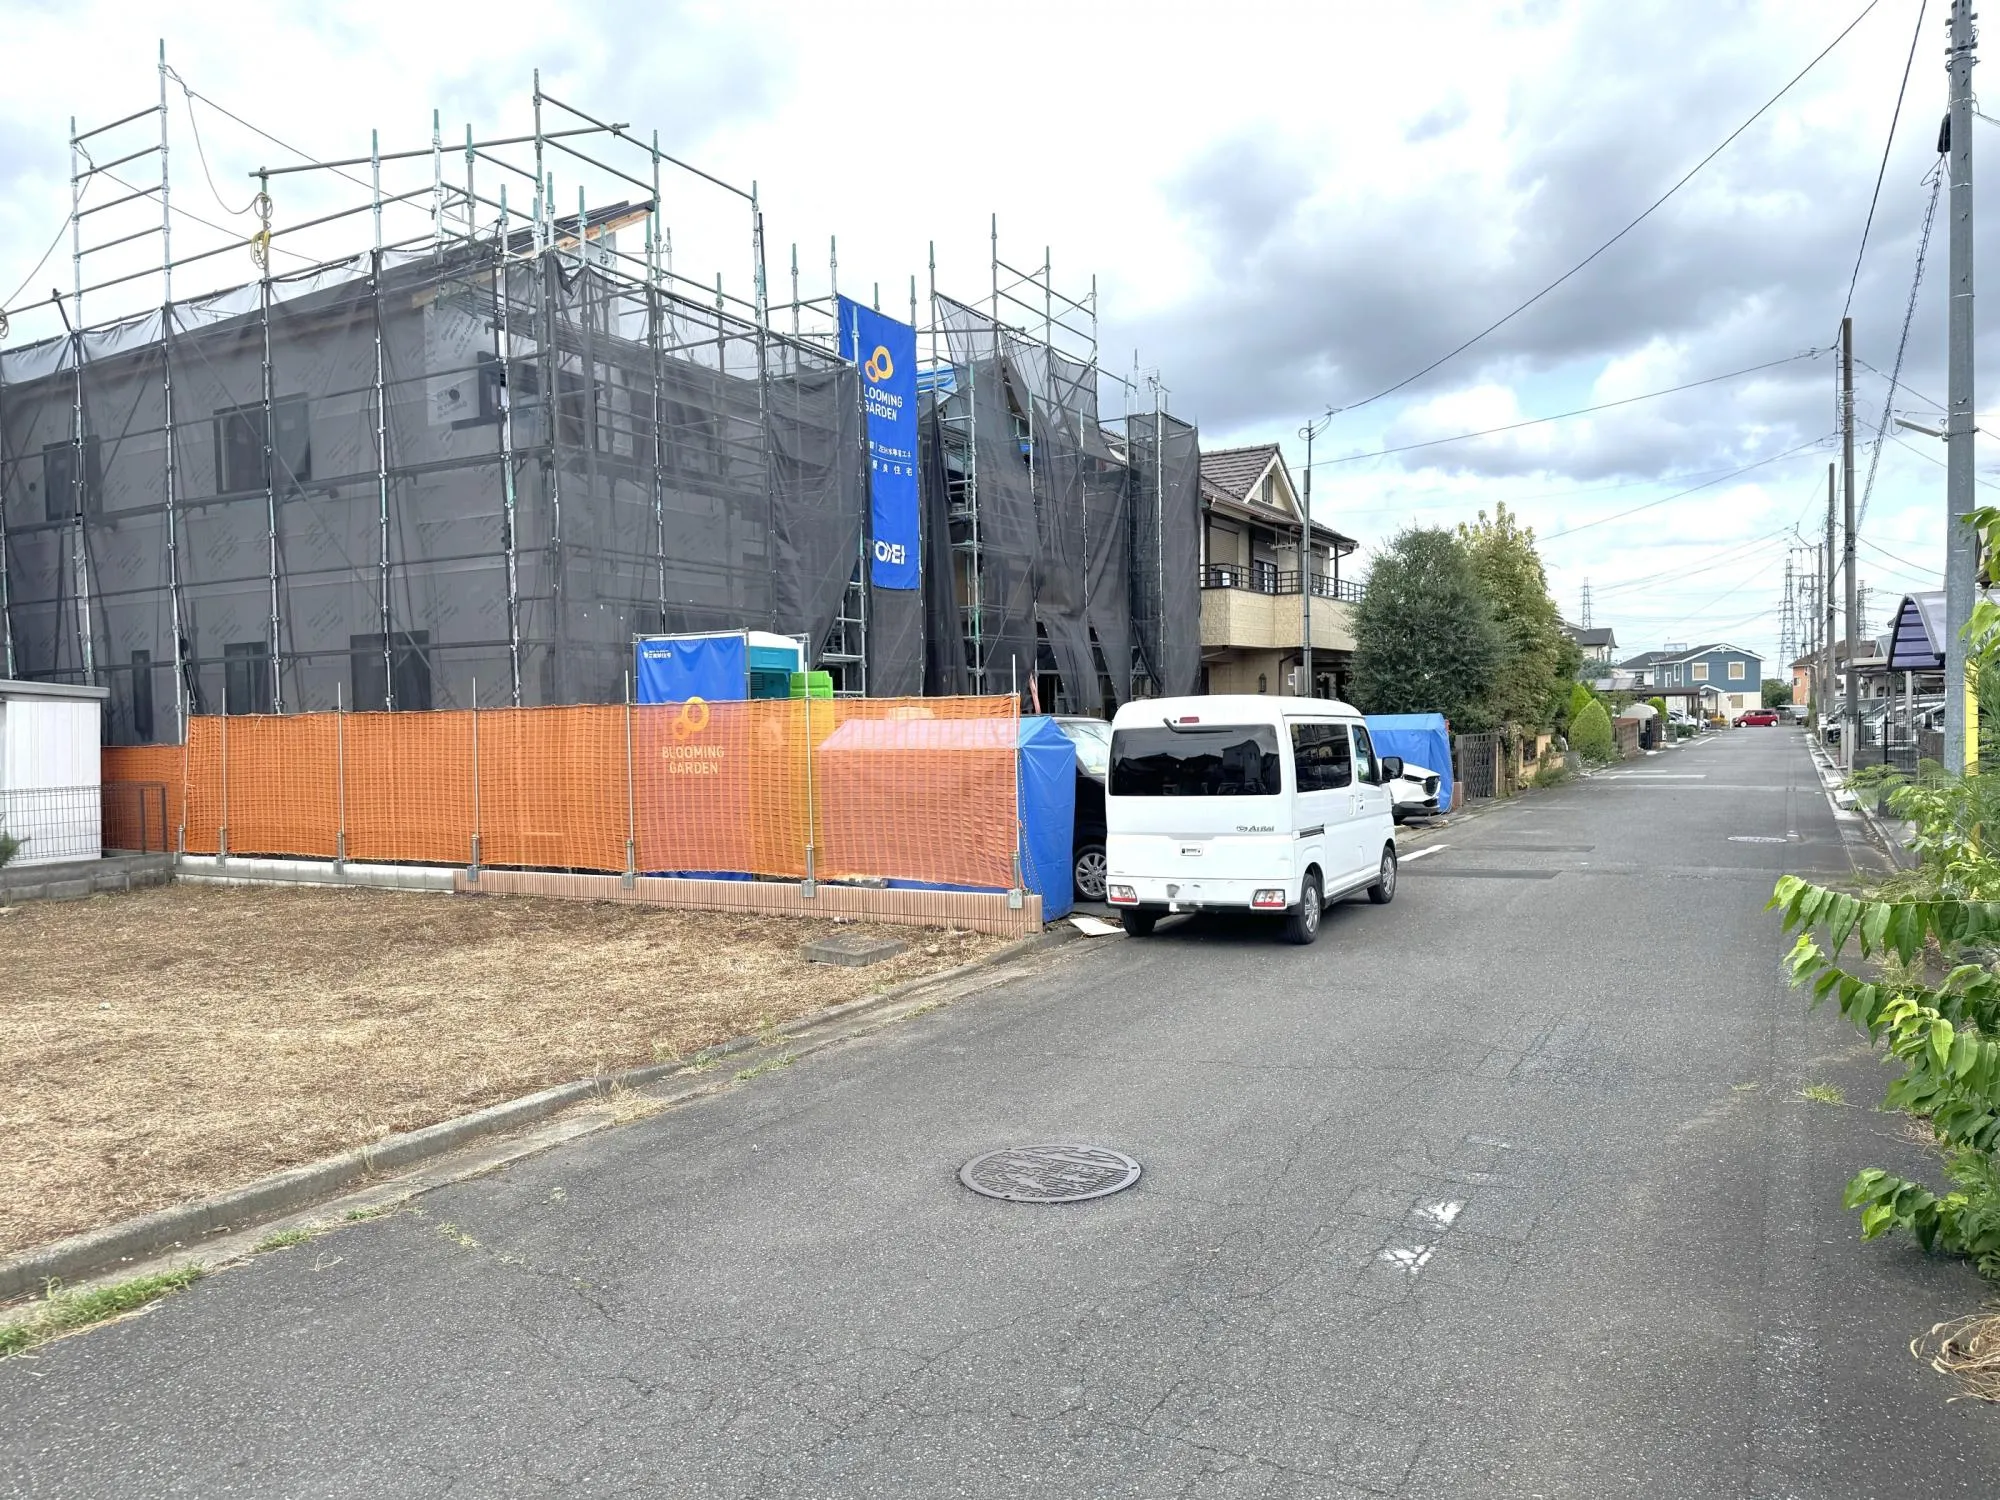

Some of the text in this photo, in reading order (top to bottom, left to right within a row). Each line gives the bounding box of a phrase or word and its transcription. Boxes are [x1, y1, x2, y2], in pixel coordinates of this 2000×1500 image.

[863, 384, 903, 408] LOOMING
[662, 745, 724, 758] BLOOMING
[669, 761, 718, 774] GARDEN
